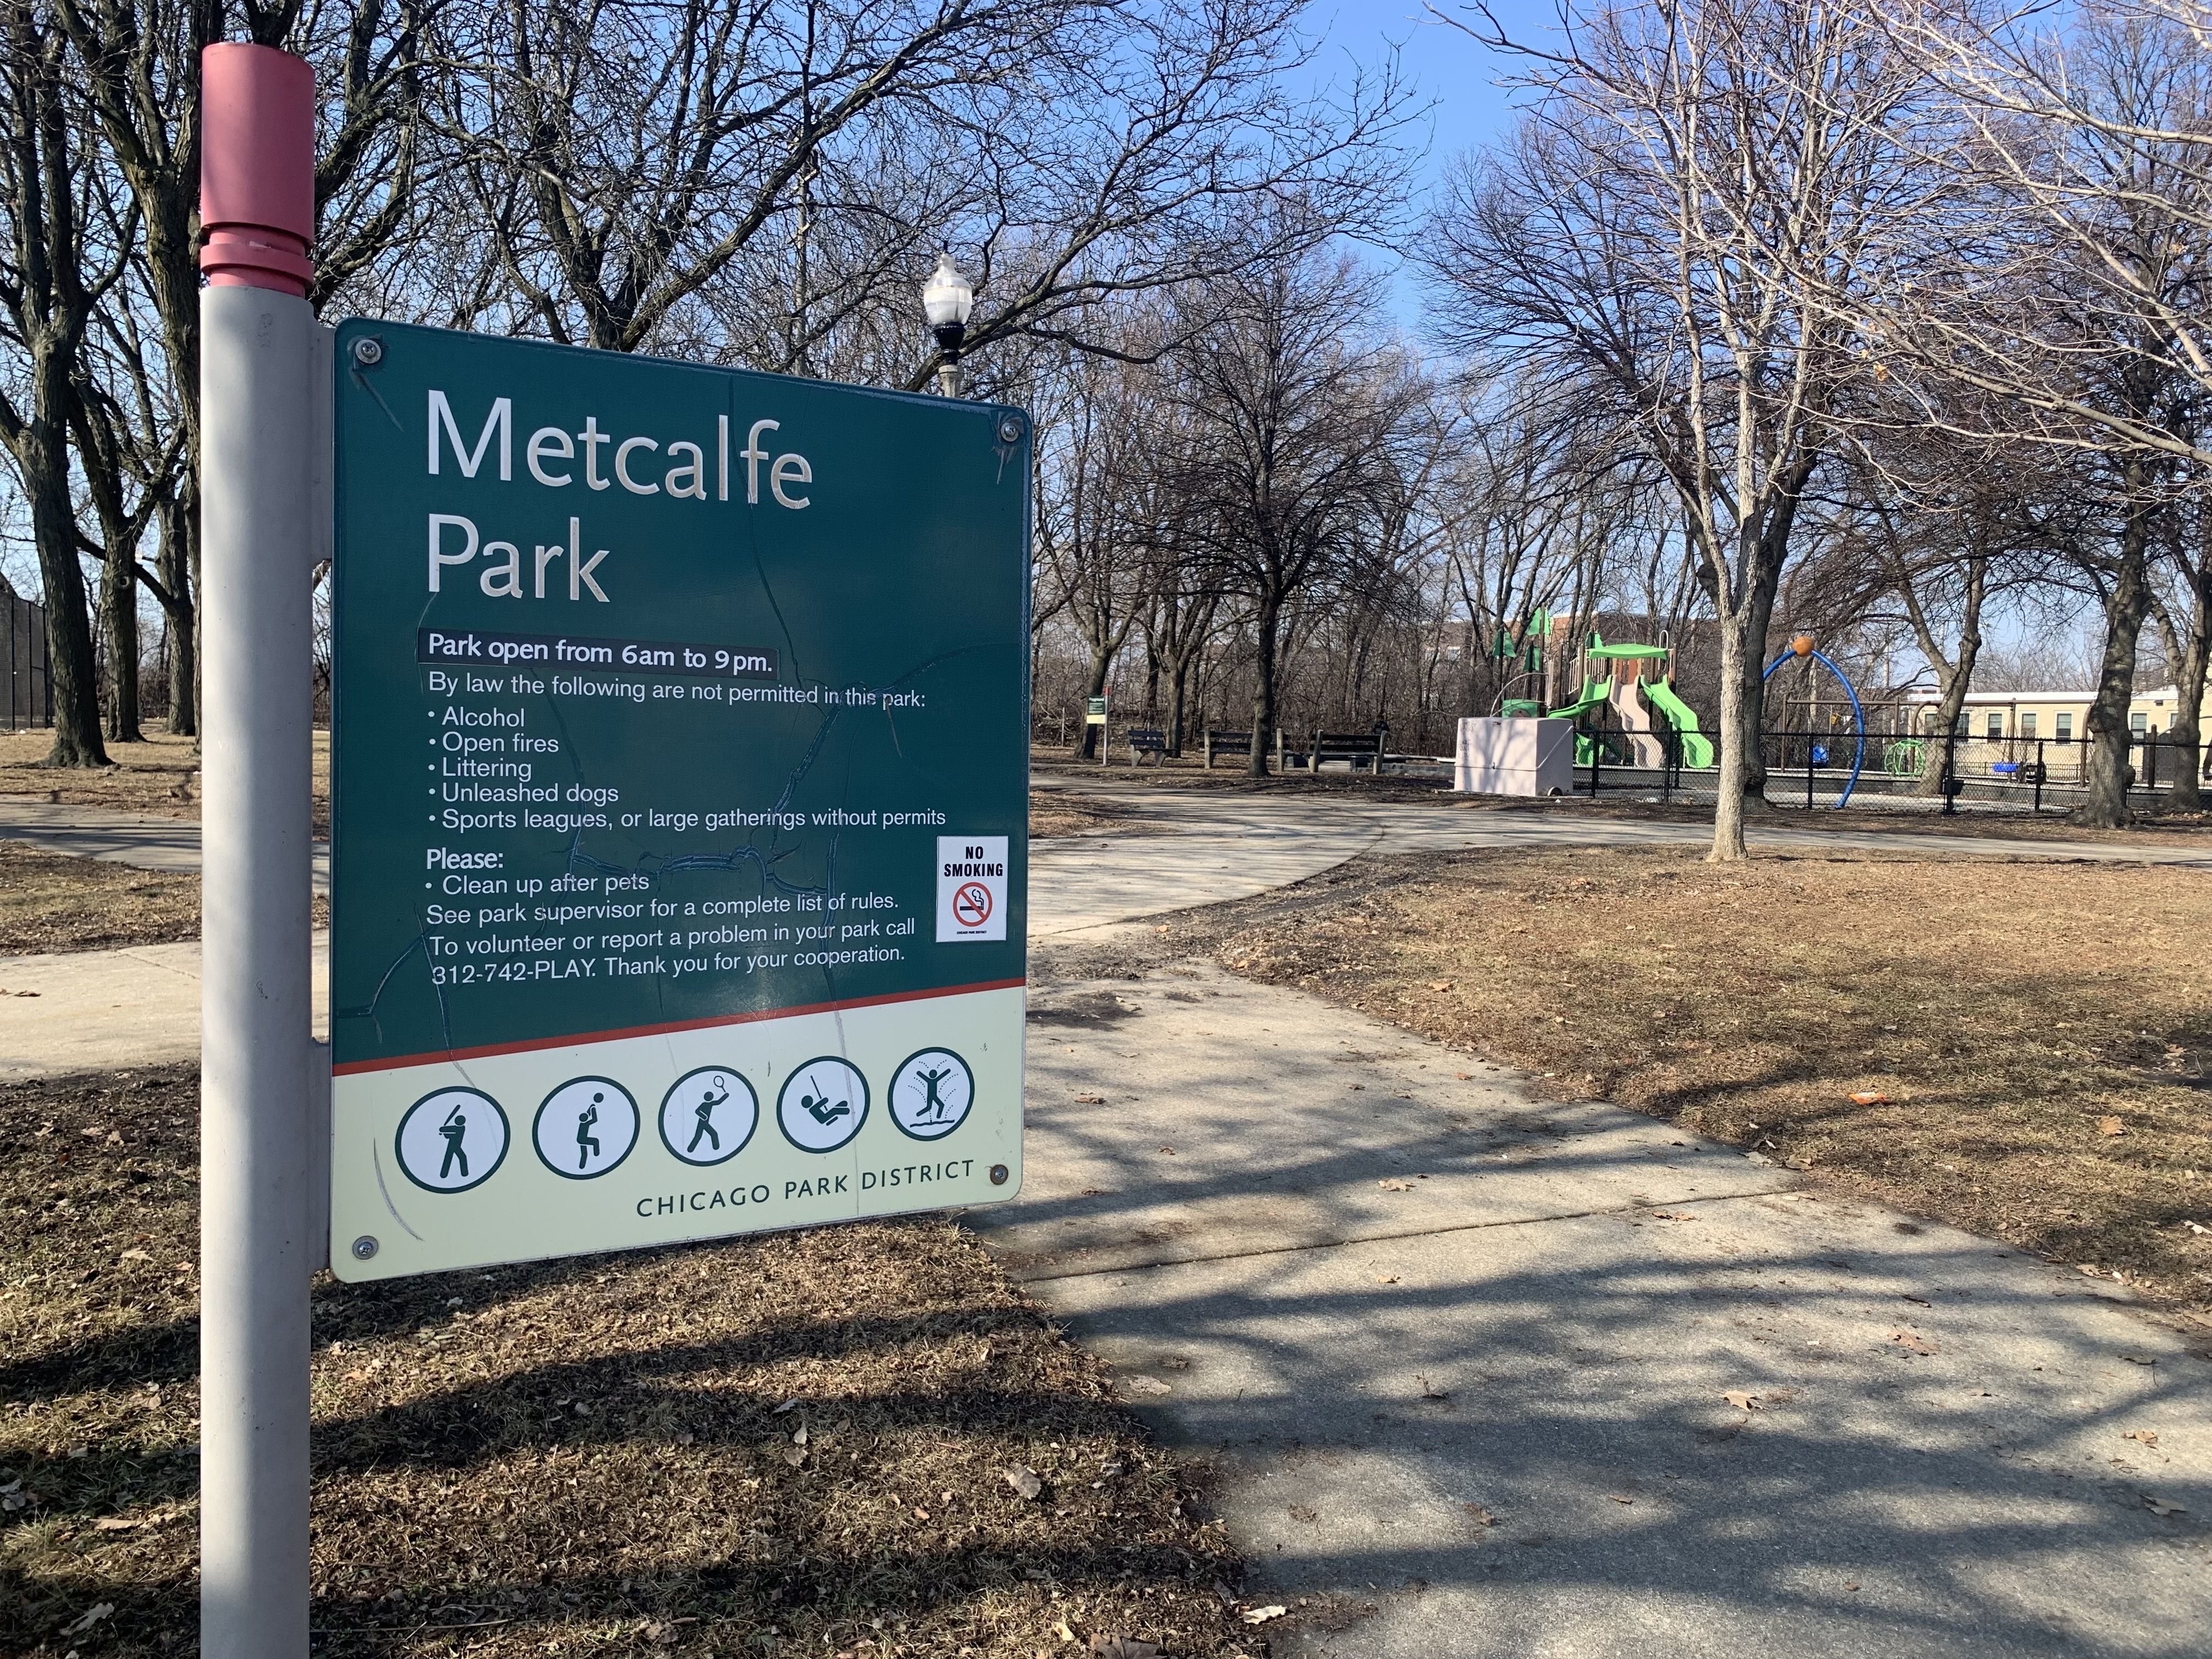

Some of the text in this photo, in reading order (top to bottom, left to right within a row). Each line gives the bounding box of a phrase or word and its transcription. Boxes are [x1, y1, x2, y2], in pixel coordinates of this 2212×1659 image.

[428, 389, 813, 510] Metcalfe
[428, 513, 611, 602] Park
[429, 633, 772, 676] Park open from 6am to 9pm.
[429, 671, 926, 710] By law the following are not permitted in this park:
[442, 706, 525, 727] Alcohol
[442, 731, 560, 757] Open fires
[442, 757, 532, 782] Littering
[442, 782, 619, 807] Unleashed dogs
[442, 808, 946, 833] Sports leagues, or large gatherings without permits
[427, 847, 504, 870] Please:
[966, 847, 983, 859] NO
[944, 864, 1003, 877] SMOKING
[443, 872, 650, 898] Clean up after pets
[426, 891, 899, 928] See park supervisor for a complete list of rules.
[430, 918, 915, 956] To volunteer or report a problem in your park call
[431, 945, 905, 985] 312-742-PLAY. Thank you for your cooperation.
[636, 1160, 974, 1217] CHICAGO PARK DISTRICT
